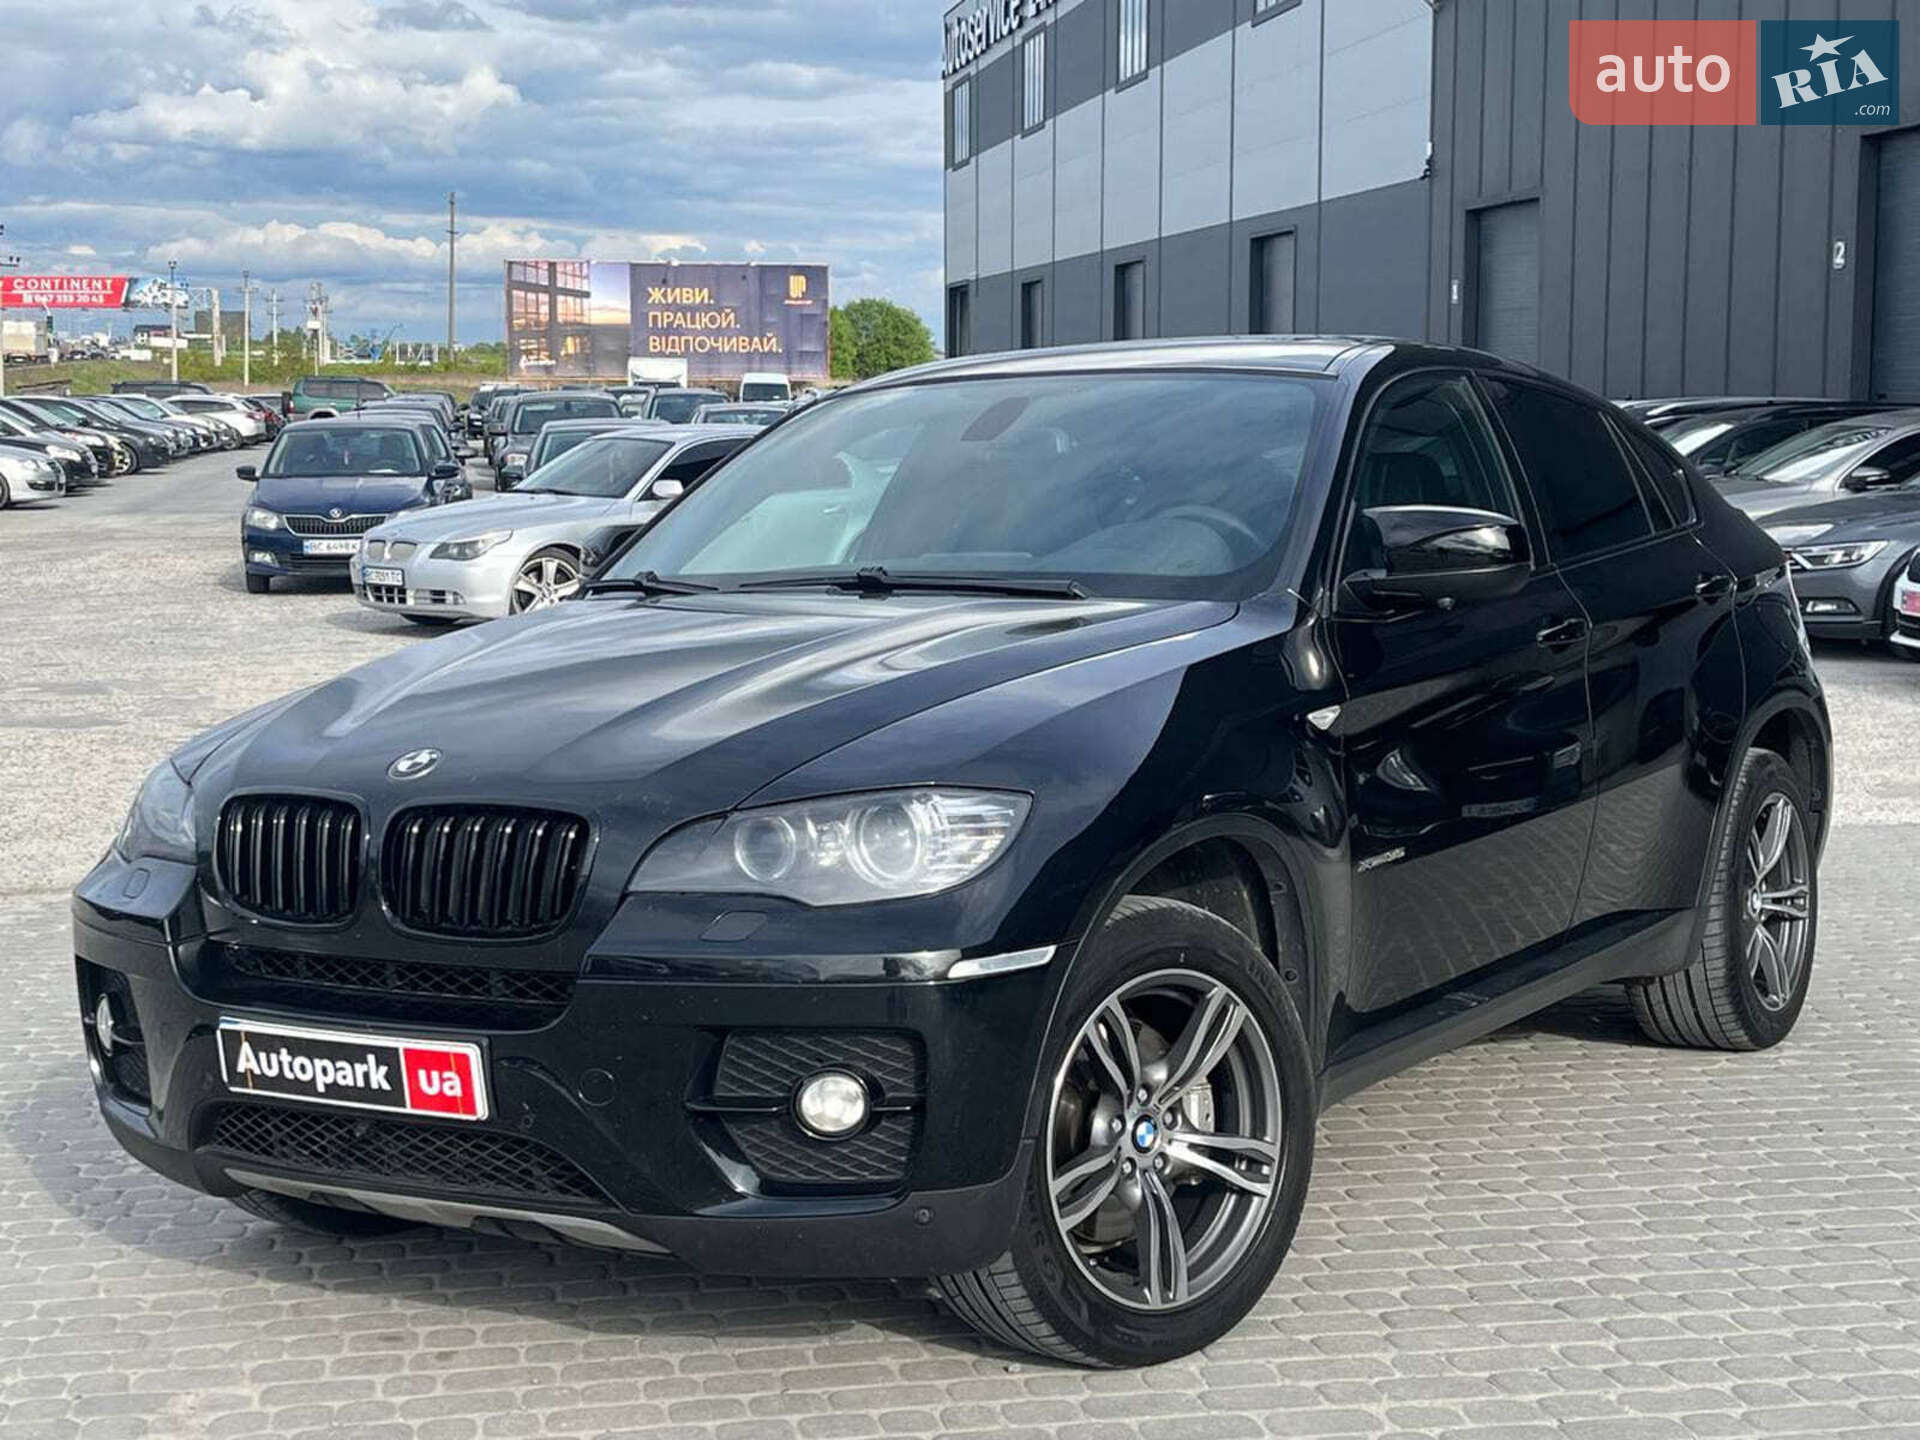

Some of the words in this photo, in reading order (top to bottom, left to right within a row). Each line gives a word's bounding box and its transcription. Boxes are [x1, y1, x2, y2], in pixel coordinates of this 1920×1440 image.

[1833, 241, 1845, 266] 2
[13, 279, 112, 290] CONTINENT
[647, 287, 714, 304] ЖИВИ.
[648, 309, 740, 330] ПРАЦЮЙ.
[649, 333, 783, 355] ВІДПОЧИВАЙ.
[237, 1040, 392, 1093] Autopark
[417, 1068, 463, 1098] ua
